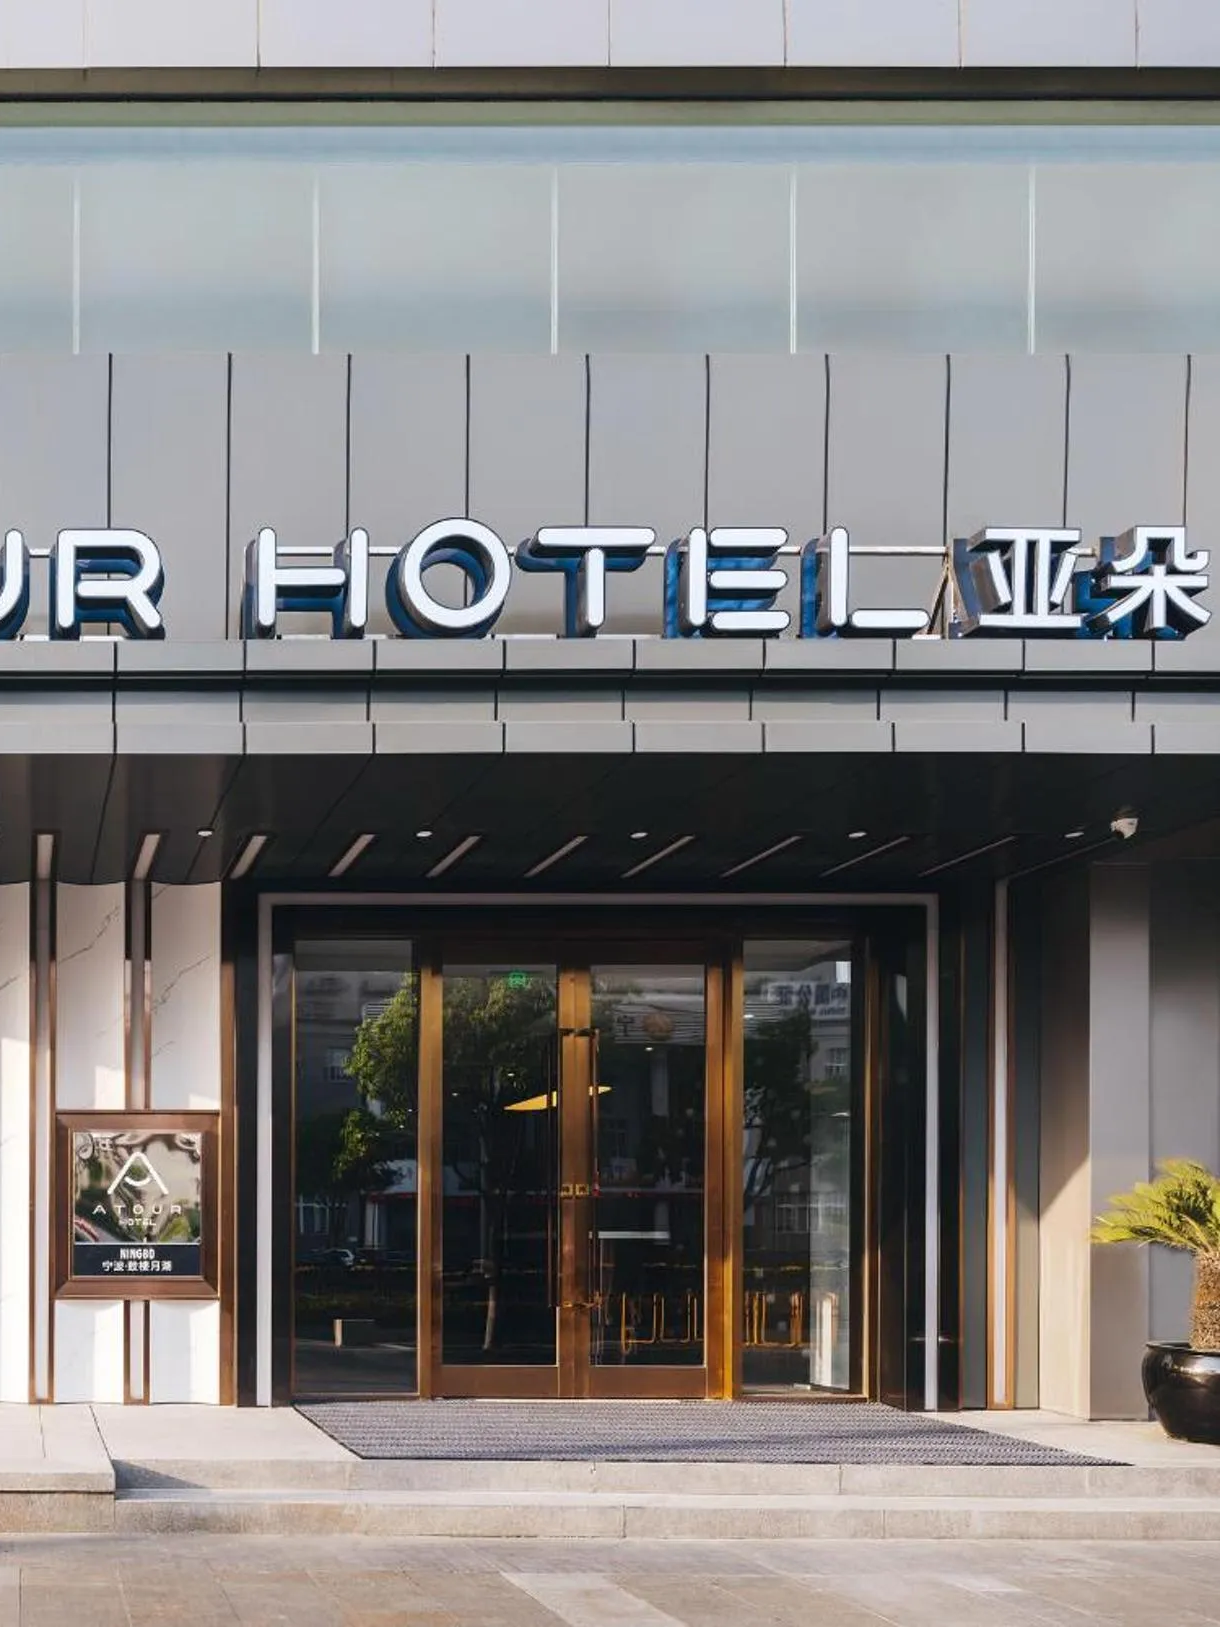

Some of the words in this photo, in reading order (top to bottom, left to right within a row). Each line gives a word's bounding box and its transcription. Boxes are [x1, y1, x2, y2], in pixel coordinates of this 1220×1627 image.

[246, 517, 930, 636] HOTEL
[970, 525, 1213, 637] 亚朵
[92, 1204, 182, 1215] ATOUR
[119, 1248, 156, 1260] NINGBO
